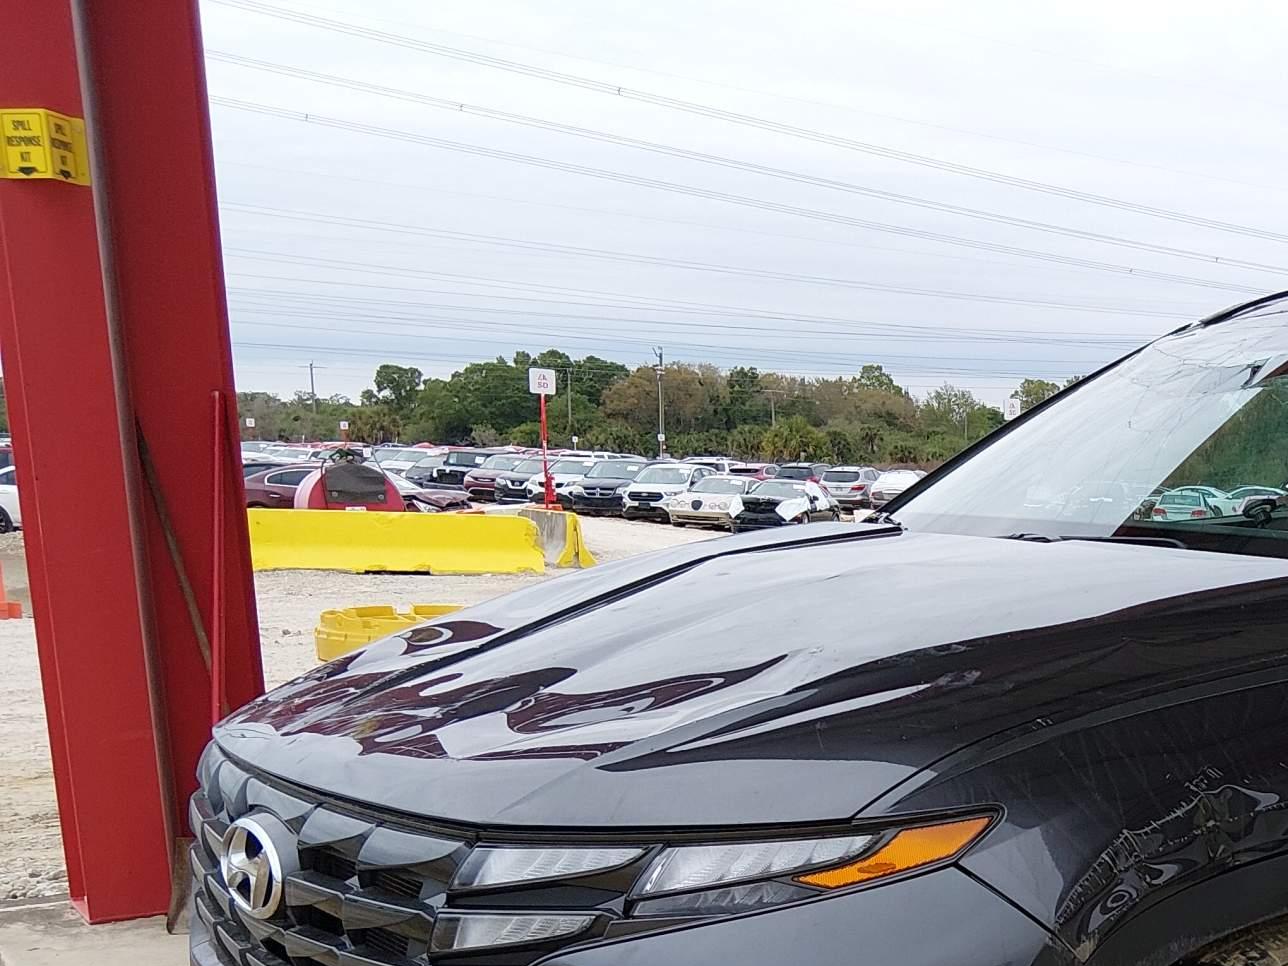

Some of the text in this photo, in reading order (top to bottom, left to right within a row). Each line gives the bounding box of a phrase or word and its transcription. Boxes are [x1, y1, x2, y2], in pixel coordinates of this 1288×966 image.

[11, 120, 32, 131] SPILL
[6, 135, 42, 147] RESPONSE
[20, 152, 31, 162] KIT
